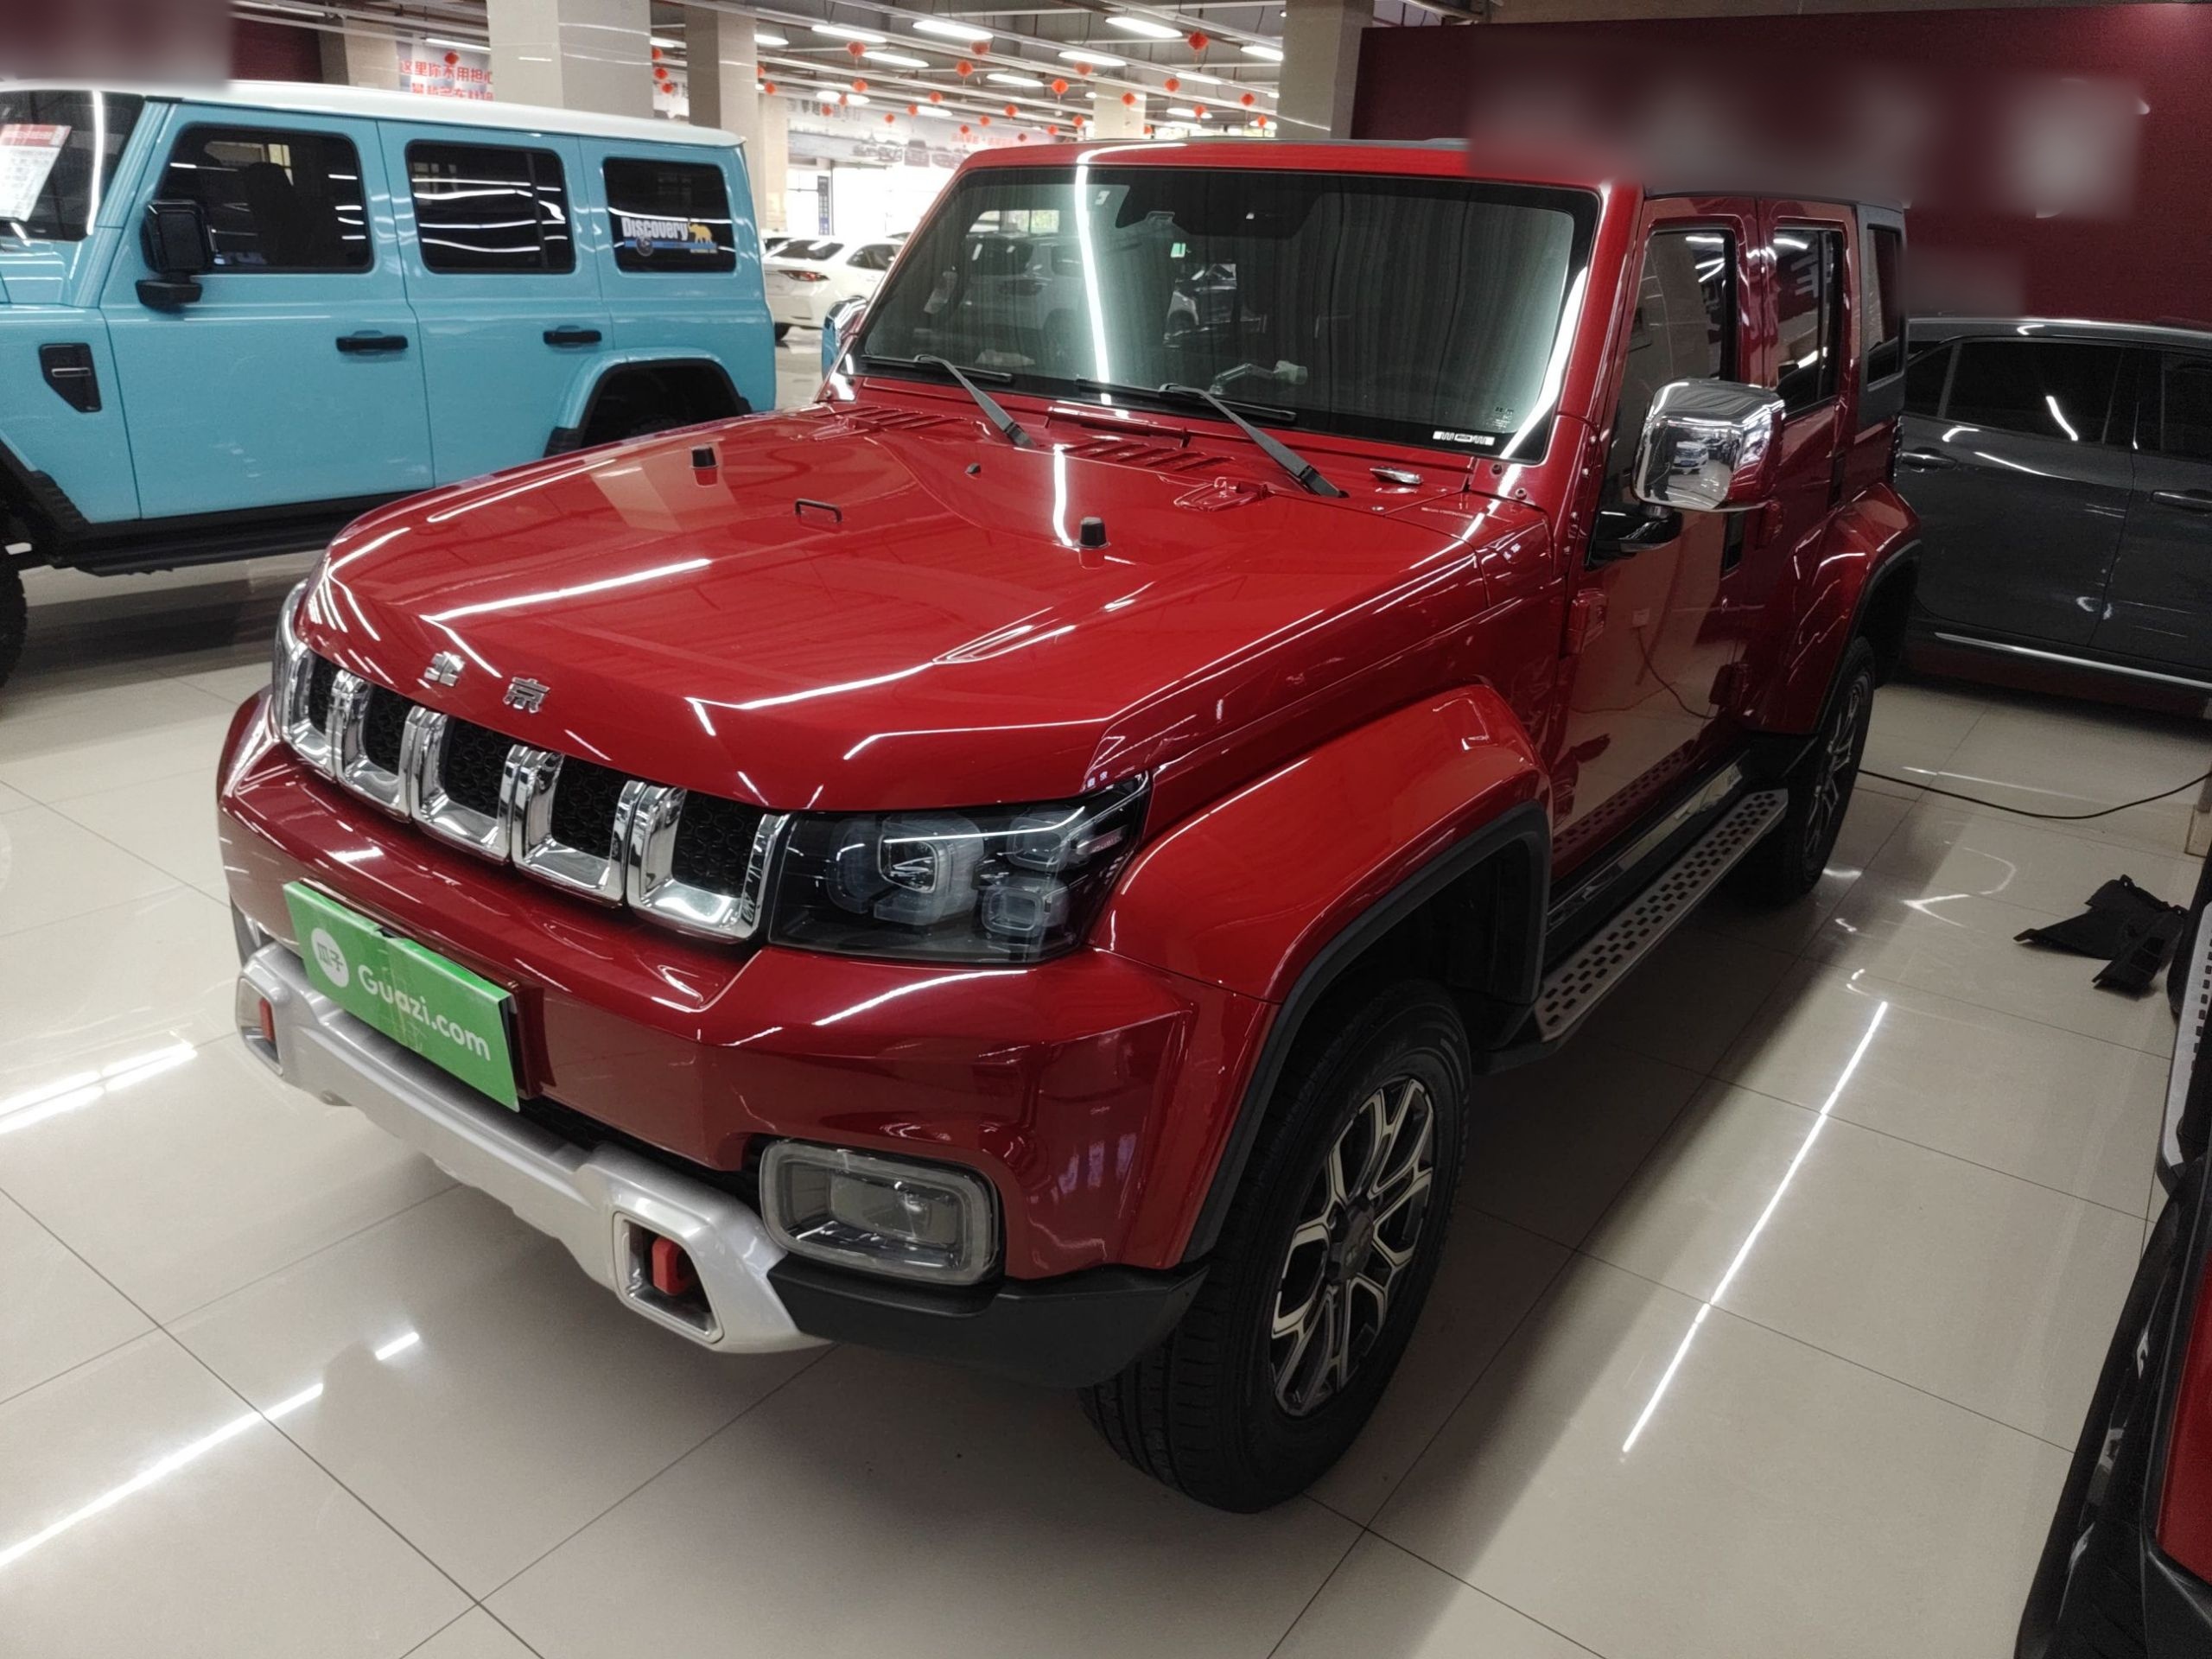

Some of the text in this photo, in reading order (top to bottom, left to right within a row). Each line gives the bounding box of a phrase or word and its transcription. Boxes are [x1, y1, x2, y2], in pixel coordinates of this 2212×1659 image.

[621, 216, 689, 241] Discovery
[423, 651, 550, 714] 北京
[316, 941, 344, 972] 瓜子
[357, 964, 491, 1061] Guazi.com
